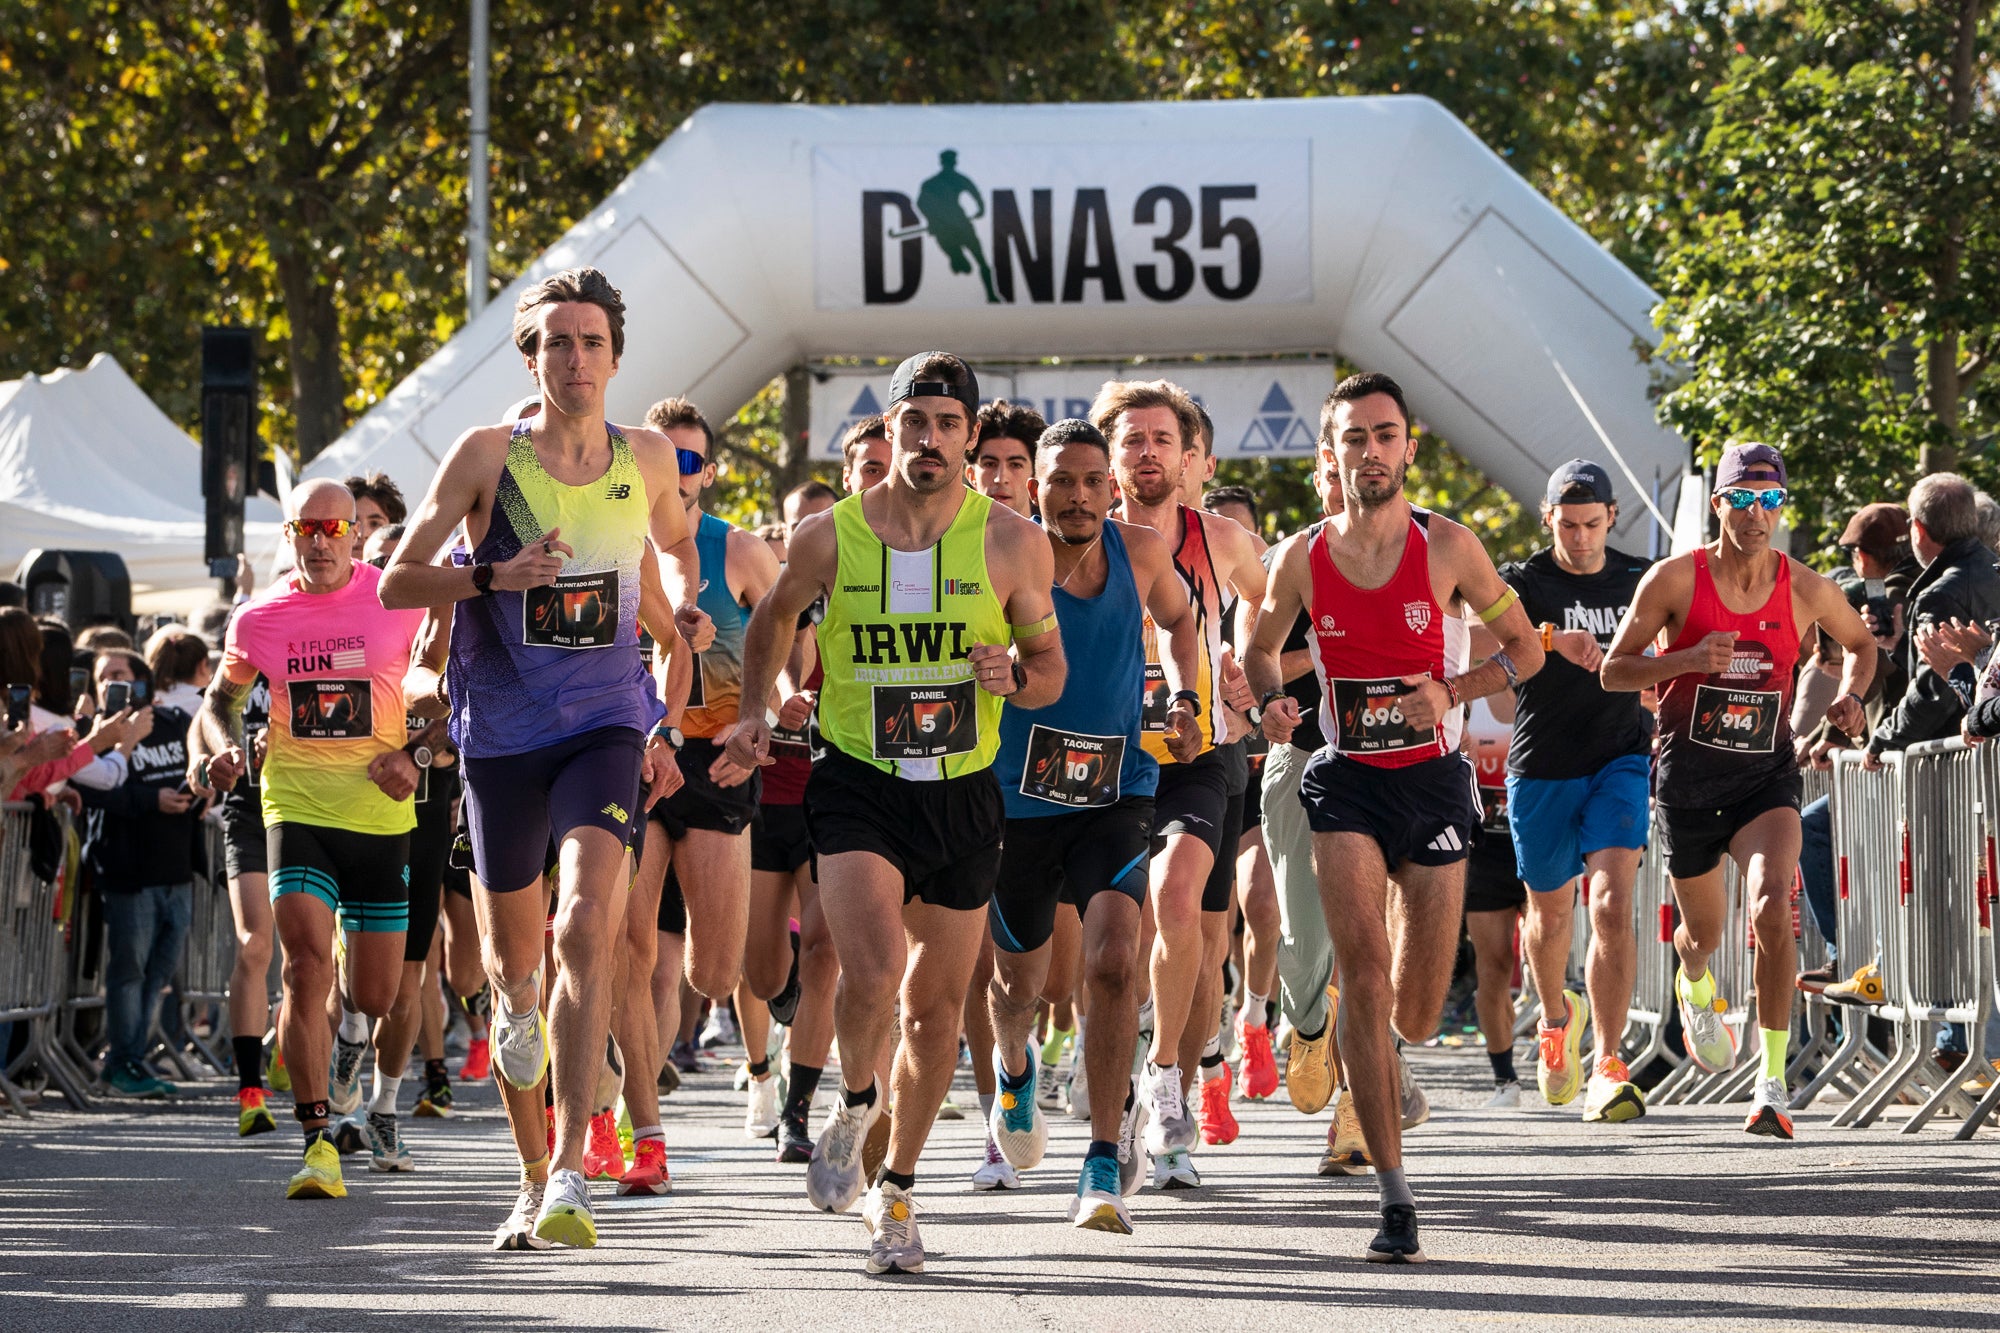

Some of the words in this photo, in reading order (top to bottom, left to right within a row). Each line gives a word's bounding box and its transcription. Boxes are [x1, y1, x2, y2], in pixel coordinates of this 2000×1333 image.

[573, 603, 582, 622] 1
[309, 636, 366, 653] FLORES
[850, 622, 973, 664] IRWL
[287, 653, 333, 675] RUN
[316, 684, 345, 692] SERGIO
[910, 691, 947, 700] DANIEL
[1366, 684, 1396, 695] MARC
[1727, 693, 1764, 705] LAHCEN
[324, 702, 336, 718] 7
[1362, 705, 1405, 727] 696
[921, 713, 936, 733] 5
[1721, 712, 1753, 731] 914
[1066, 760, 1089, 781] 10
